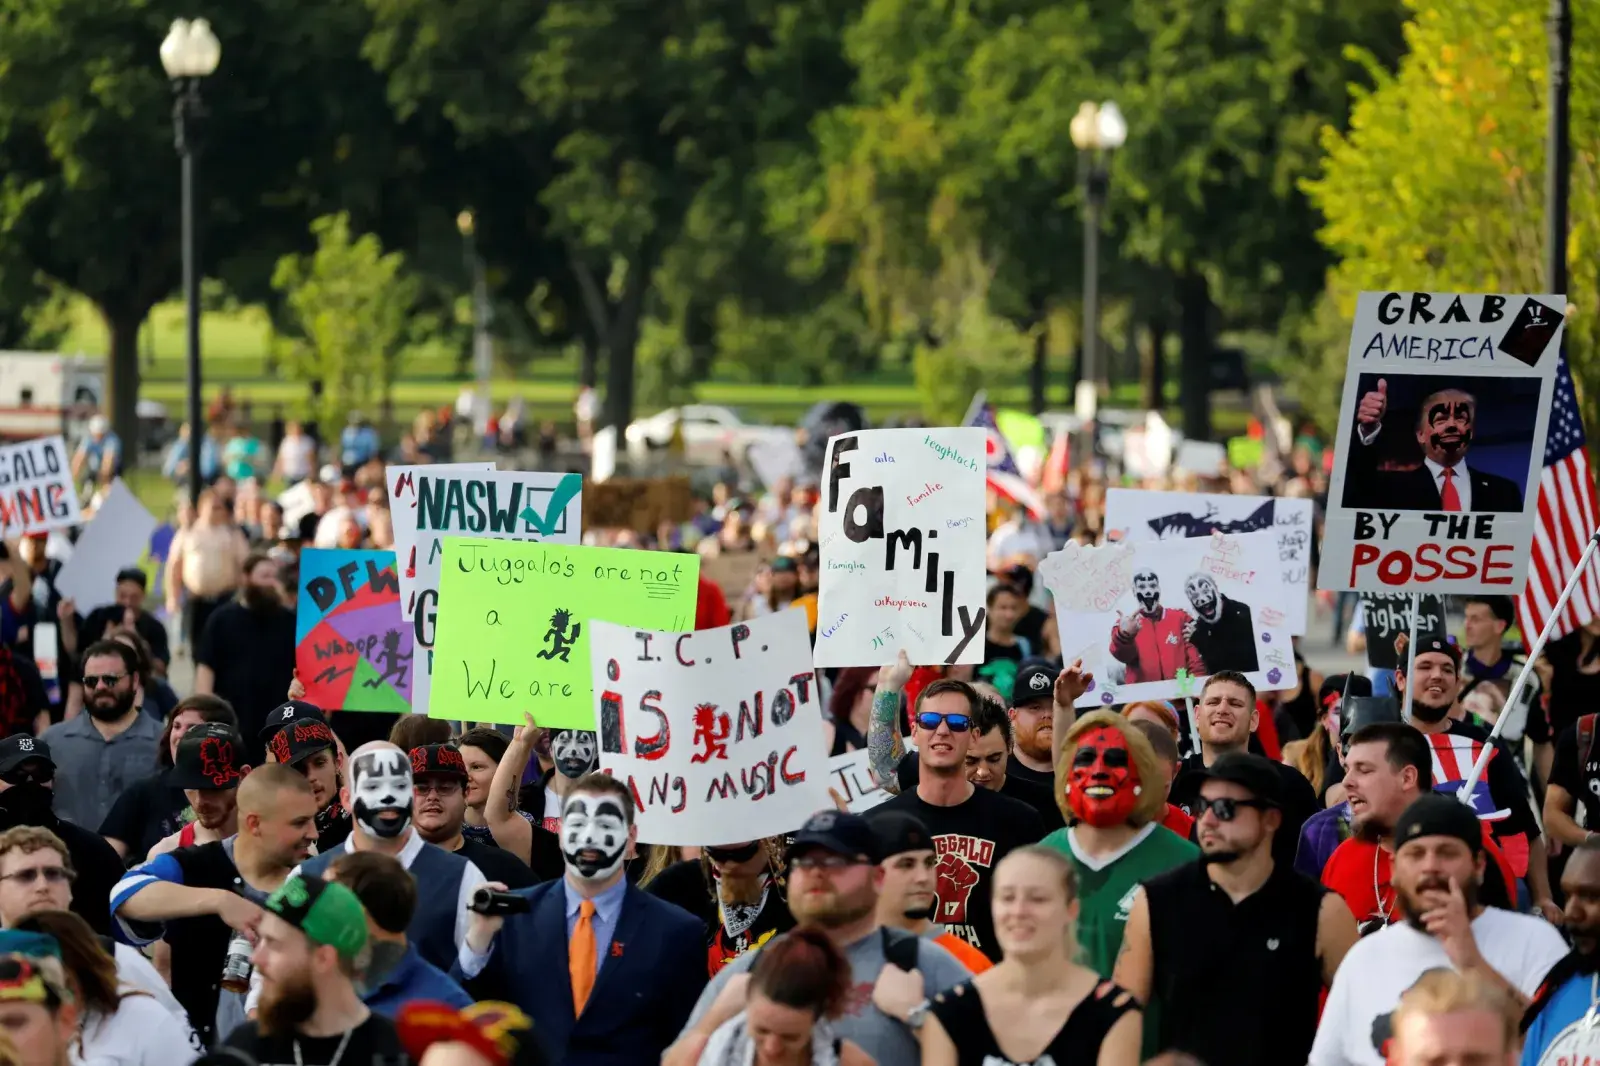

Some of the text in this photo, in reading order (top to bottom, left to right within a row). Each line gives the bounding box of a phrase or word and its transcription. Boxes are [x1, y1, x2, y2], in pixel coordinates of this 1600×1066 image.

[1377, 292, 1507, 325] GRAB
[1362, 331, 1496, 363] AMERICA
[416, 475, 524, 534] NASW
[1353, 512, 1496, 541] BY THE
[458, 544, 684, 585] Juggalo's are not
[828, 435, 986, 665] Family
[1349, 543, 1515, 589] POSSE
[305, 557, 400, 612] DFW
[486, 610, 501, 627] a
[462, 658, 516, 700] We
[529, 681, 573, 698] are
[734, 671, 814, 744] NOT
[944, 901, 960, 916] 17
